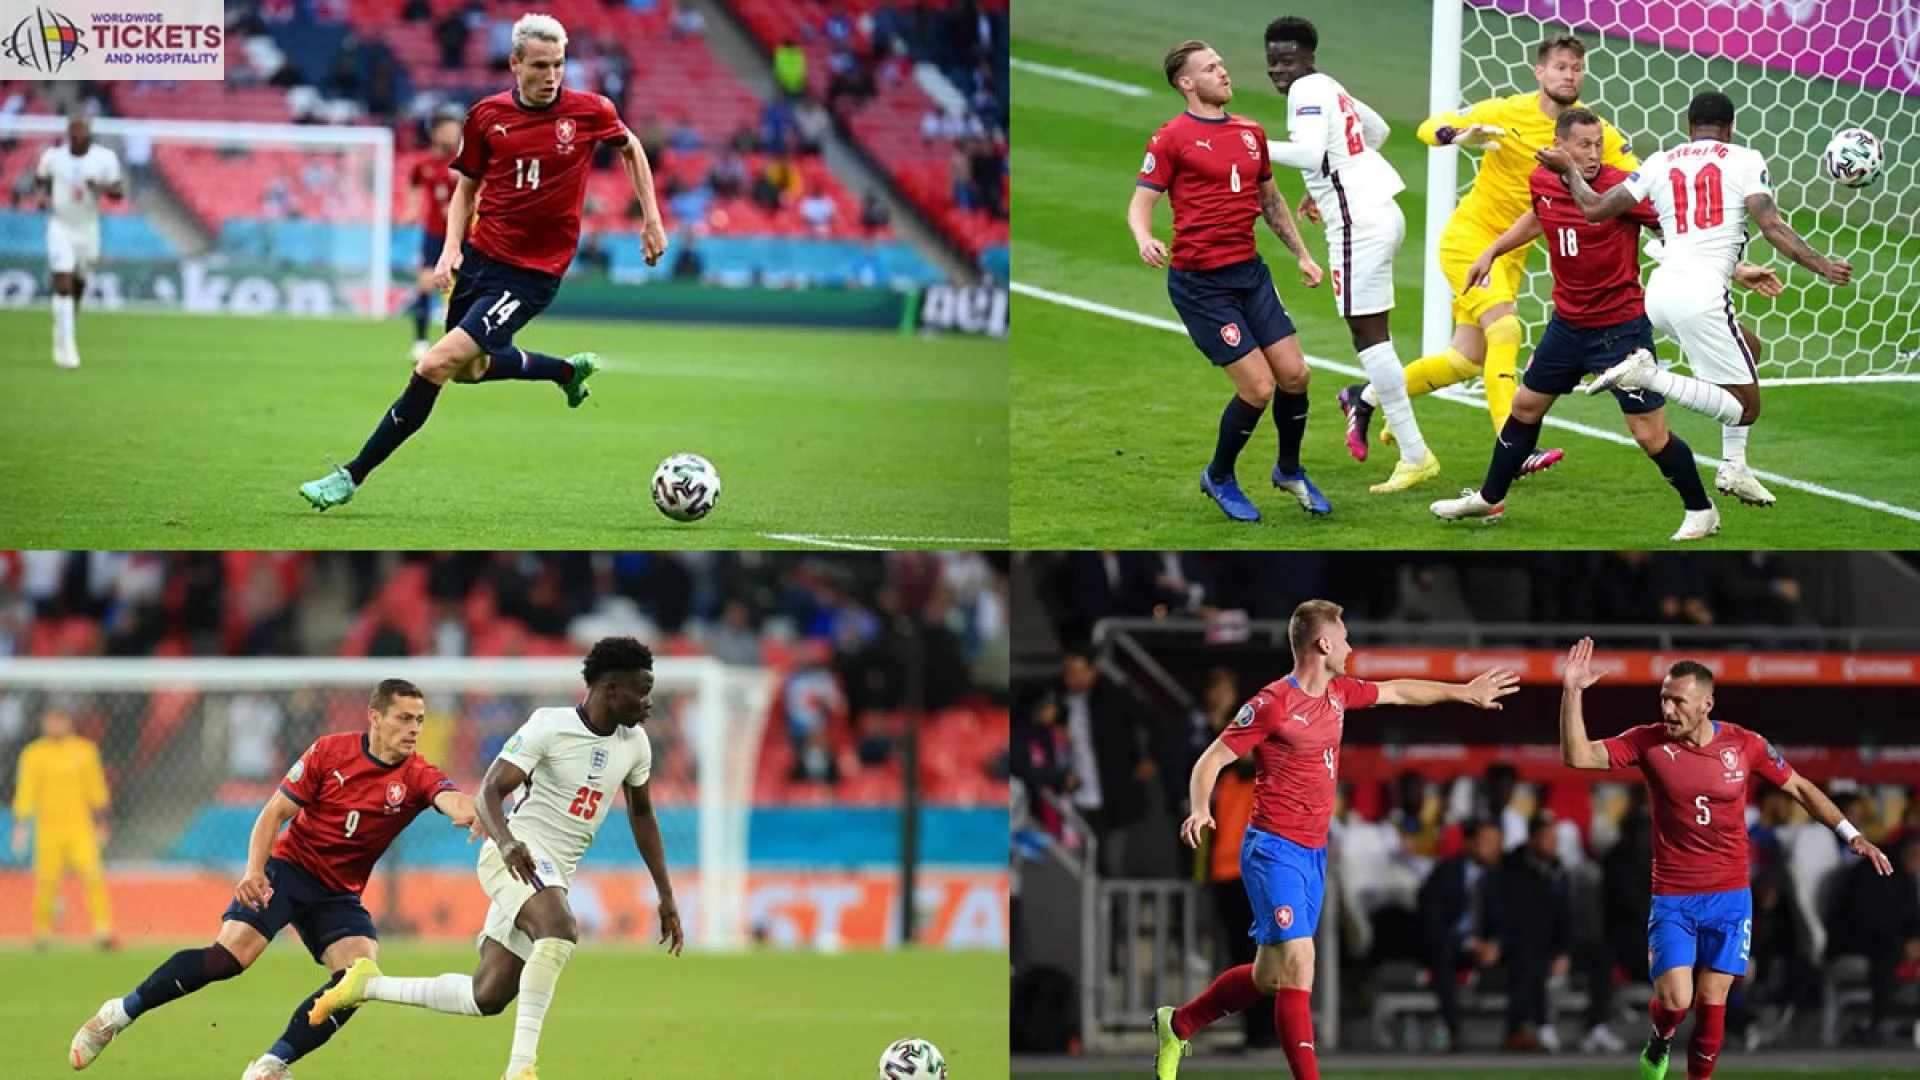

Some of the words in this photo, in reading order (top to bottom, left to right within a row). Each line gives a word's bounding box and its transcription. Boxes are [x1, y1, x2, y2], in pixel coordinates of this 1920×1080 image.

[515, 158, 541, 190] 14
[1230, 164, 1241, 193] 6
[1669, 162, 1724, 235] 10
[1558, 228, 1579, 257] 18
[486, 290, 522, 326] 14
[1322, 746, 1335, 780] 4
[568, 786, 603, 820] 25
[344, 810, 360, 838] 9
